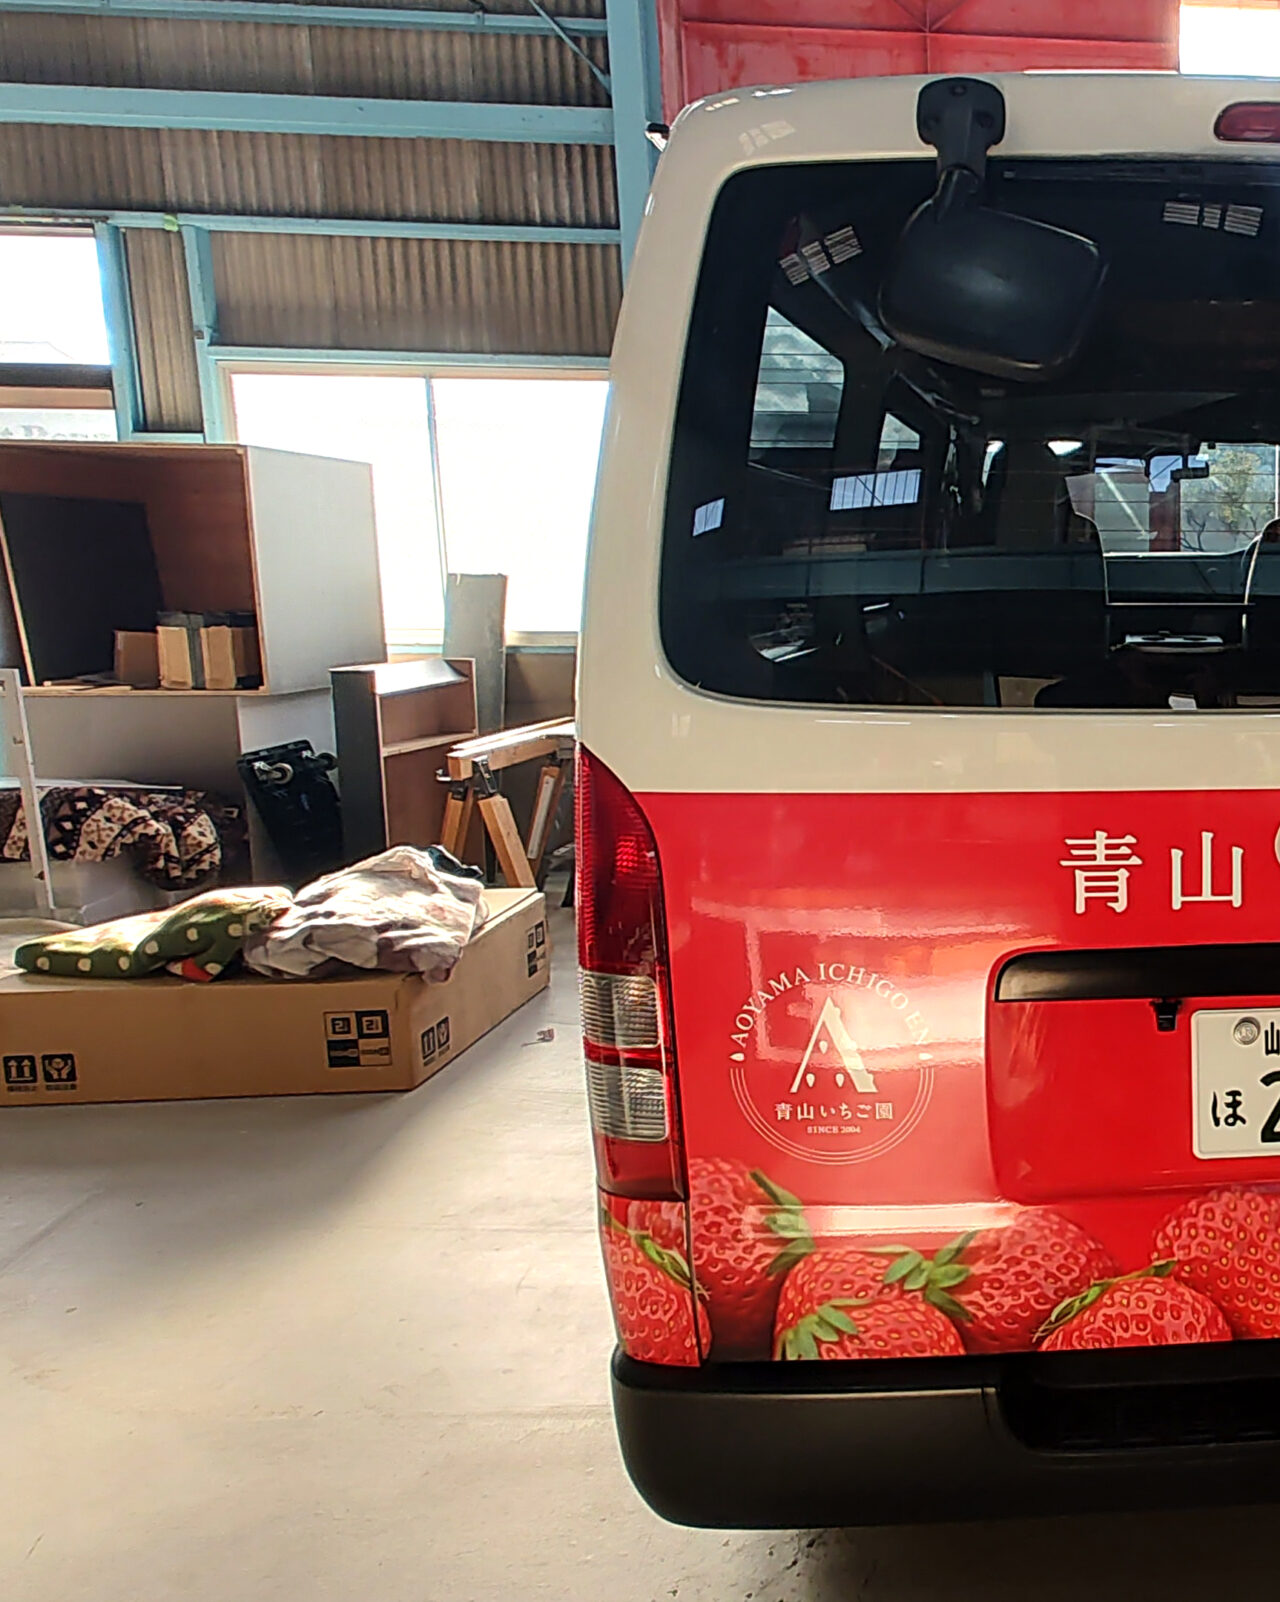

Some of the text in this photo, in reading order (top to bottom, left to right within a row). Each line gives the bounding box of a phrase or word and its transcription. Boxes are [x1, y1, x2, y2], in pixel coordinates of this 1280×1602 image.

[1059, 830, 1244, 914] 青山
[730, 967, 811, 1049] AOYAMA
[818, 963, 909, 1011] ICHIGO
[774, 1102, 894, 1121] 青山いちご園
[807, 1125, 839, 1134] SINCE
